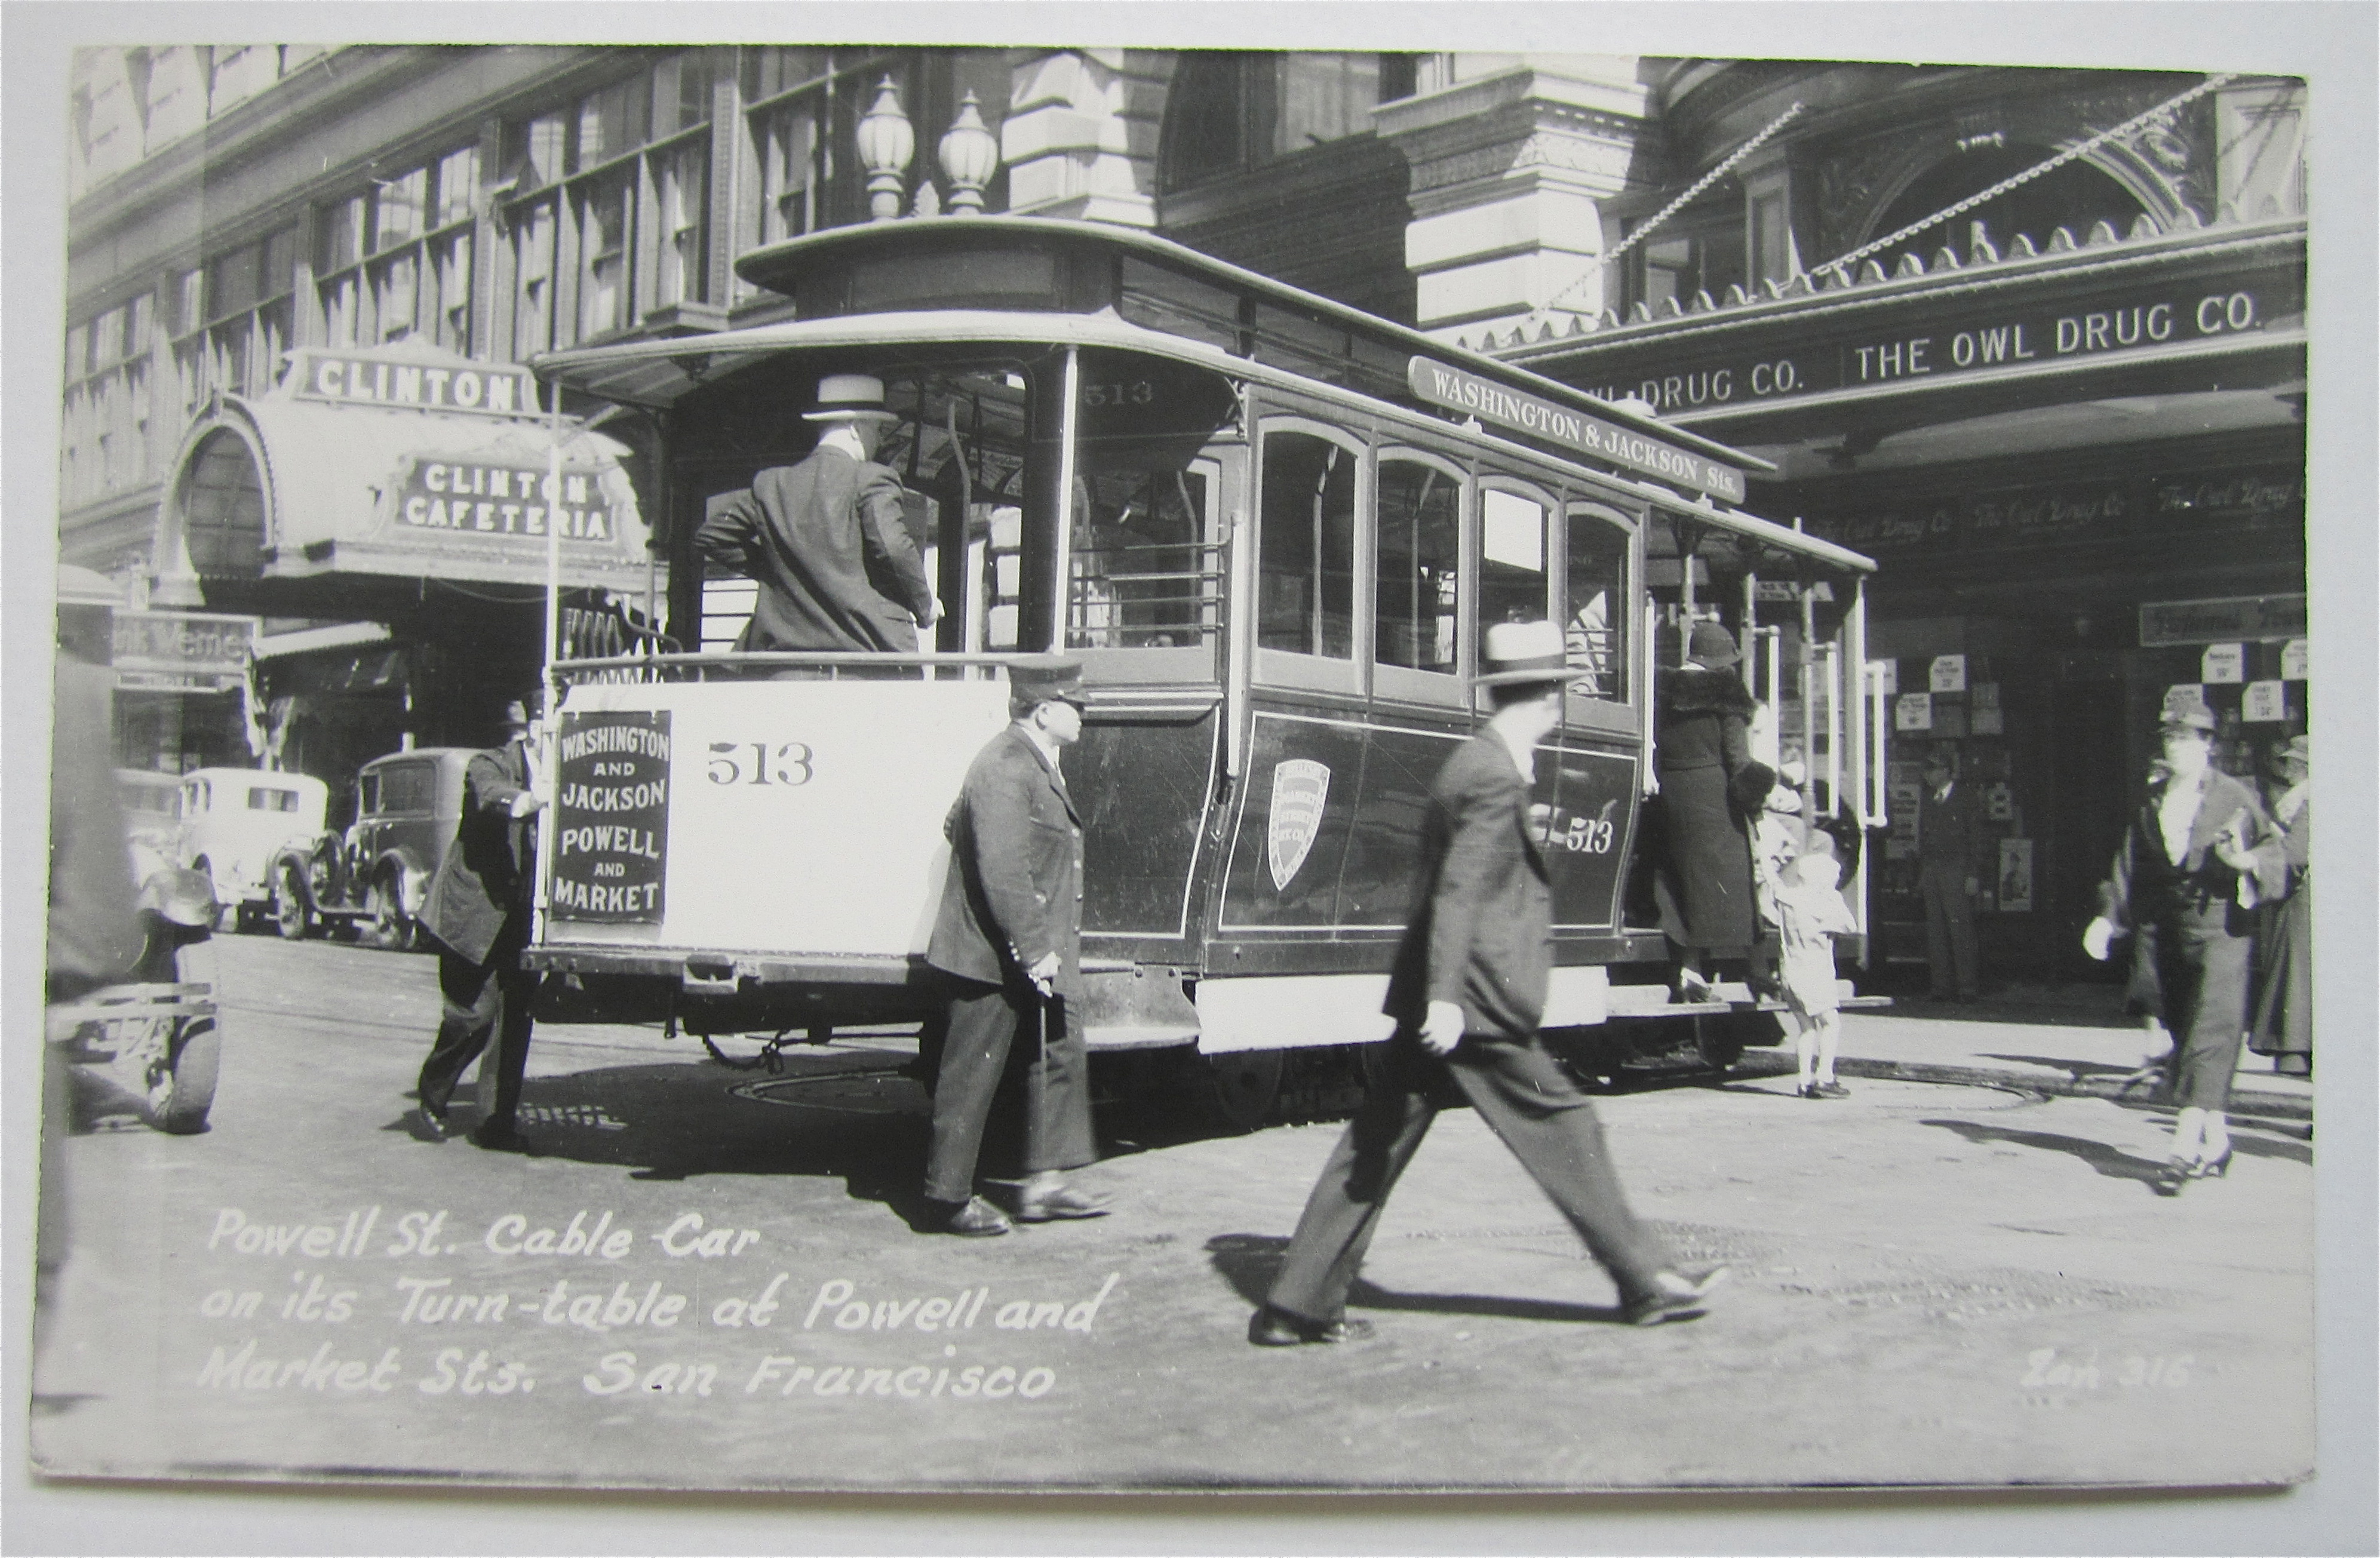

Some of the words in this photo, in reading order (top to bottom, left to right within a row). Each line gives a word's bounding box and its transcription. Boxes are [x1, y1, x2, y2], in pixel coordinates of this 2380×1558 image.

[1856, 338, 1931, 380] THE
[1952, 324, 2034, 368] OWL
[2056, 303, 2172, 355] DRUG
[2196, 292, 2264, 334] CO.
[318, 361, 513, 411] CLINTON
[1085, 381, 1153, 407] 513
[1642, 369, 1731, 408] DRUG
[1751, 360, 1804, 395] CO.
[1433, 368, 1580, 444] WASHINGTON
[1586, 423, 1602, 449] &
[1604, 431, 1699, 481] JACKSON
[406, 497, 607, 537] CAFETERIA
[561, 726, 670, 762] WASHINGTON
[594, 762, 636, 776] AND
[708, 742, 813, 786] 513
[562, 779, 666, 812] JACKSON
[561, 825, 660, 860] POWELL
[1566, 817, 1614, 855] 513
[594, 862, 625, 877] AND
[554, 877, 658, 912] MARKET
